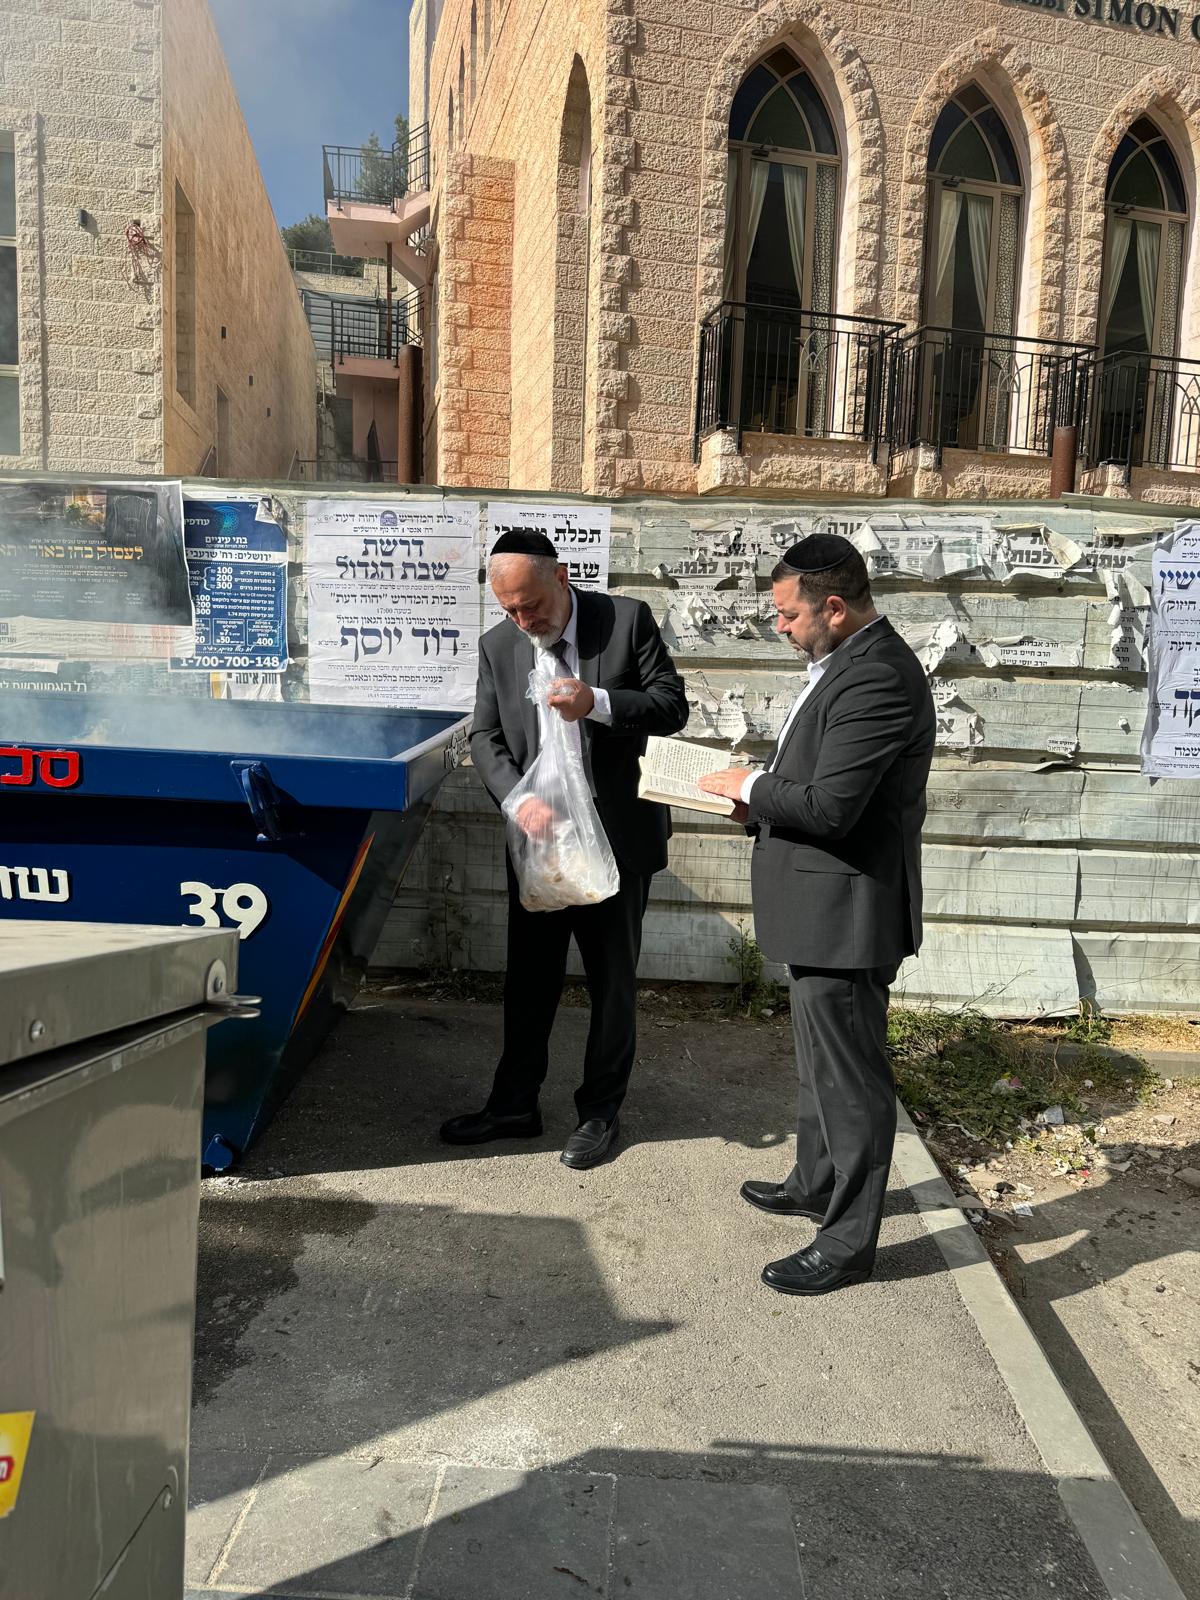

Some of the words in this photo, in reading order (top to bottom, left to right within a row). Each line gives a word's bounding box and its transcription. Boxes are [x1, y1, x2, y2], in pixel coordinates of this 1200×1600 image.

[1074, 0, 1179, 35] SIMON
[184, 518, 210, 526] עודפי
[399, 514, 434, 523] המדרש
[437, 514, 454, 523] בית
[553, 519, 602, 544] תכלת
[205, 536, 231, 544] עיניים
[233, 536, 248, 544] בתי
[362, 538, 425, 557] דרשת
[67, 545, 94, 560] בהן
[97, 545, 144, 560] לעסוק
[189, 549, 218, 558] שרעבי
[219, 550, 233, 558] רח'
[234, 551, 272, 561] ירושלים:
[217, 566, 233, 574] 100
[335, 555, 394, 580] הגדול
[400, 561, 450, 580] שבת
[558, 560, 600, 578] שב
[216, 573, 233, 582] 200
[216, 581, 233, 590] 300
[195, 594, 211, 602] 100
[330, 592, 357, 604] דעת"
[390, 594, 429, 605] המדרש
[432, 594, 457, 605] בבית
[195, 601, 211, 609] 200
[1166, 600, 1197, 613] חיזוק
[336, 614, 359, 624] הגדול
[361, 615, 383, 626] הגאון
[385, 616, 404, 625] ורבנו
[405, 616, 426, 625] מורנו
[428, 616, 452, 625] ידרוש
[220, 636, 231, 644] 50
[256, 637, 274, 646] 400
[340, 625, 403, 663] יוסף
[411, 627, 460, 657] דוד
[1019, 640, 1044, 648] אברהם
[1167, 640, 1193, 652] דעת'
[180, 655, 280, 668] 1-700-700-148
[344, 674, 371, 682] ובאגדה
[373, 673, 398, 682] בהלכה
[422, 675, 444, 683] בעניני
[180, 881, 268, 940] 39
